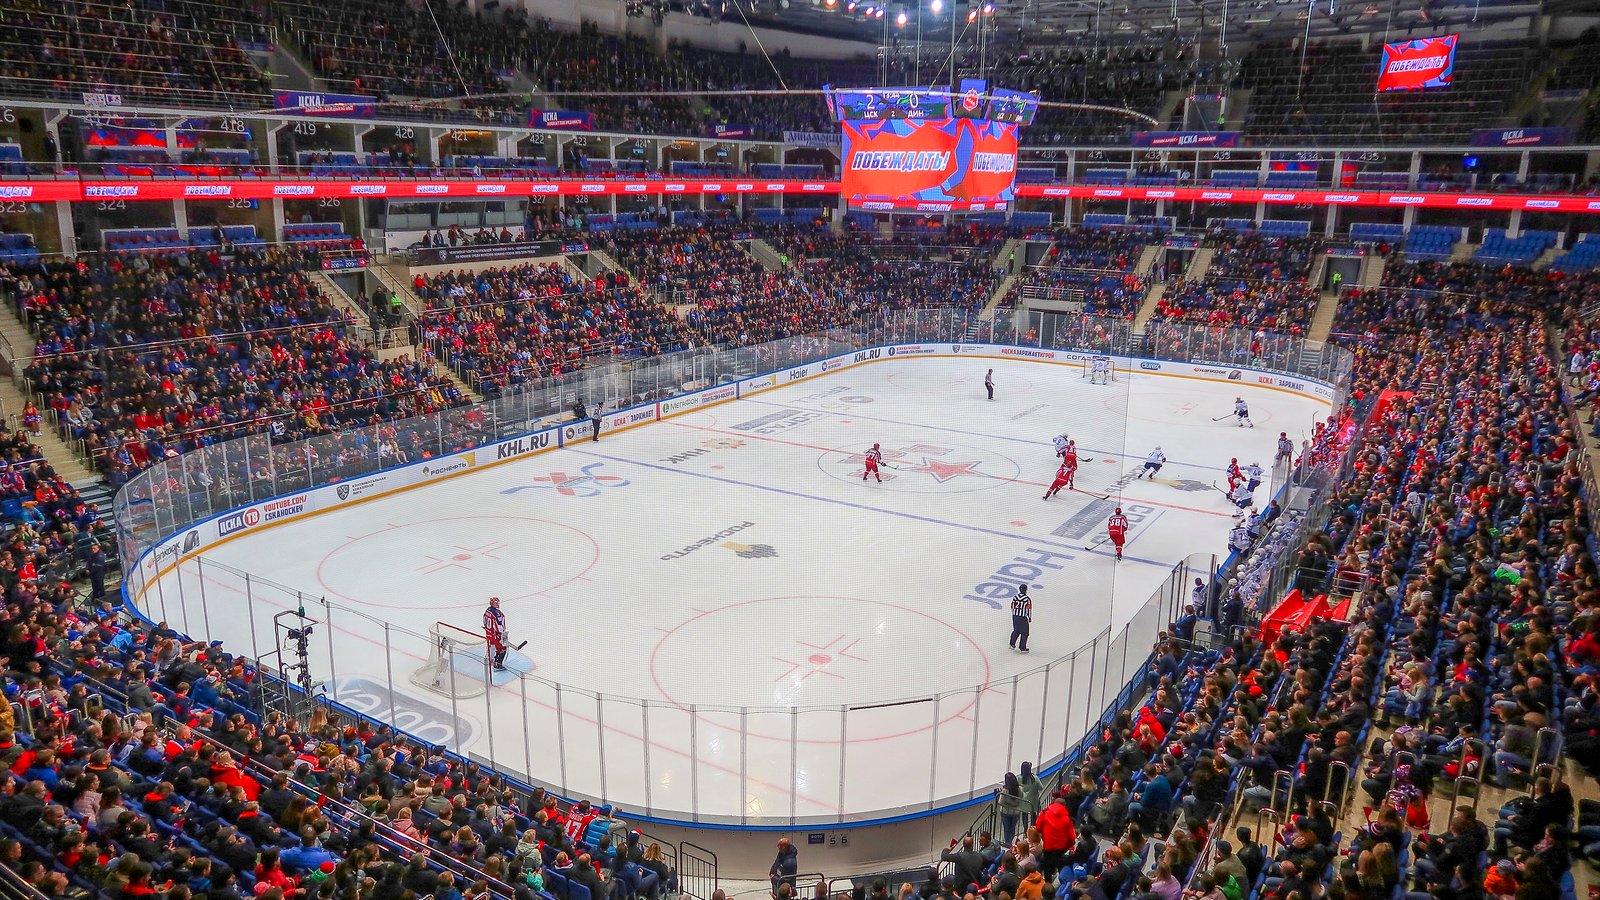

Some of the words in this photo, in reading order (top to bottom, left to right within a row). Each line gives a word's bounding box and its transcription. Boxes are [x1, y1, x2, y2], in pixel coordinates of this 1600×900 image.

[1387, 55, 1447, 73] ПОБЕЖДАТЬ!
[298, 95, 320, 107] ЦСКА
[866, 94, 875, 109] 2
[909, 93, 918, 108] 0
[542, 112, 558, 122] ЦСКА
[908, 110, 924, 118] ДИН
[220, 120, 245, 132] 418
[294, 123, 316, 135] 419
[395, 127, 414, 139] 420
[451, 129, 468, 141] 421
[1502, 130, 1523, 140] ЦСКА
[530, 135, 544, 144] 422
[573, 136, 587, 146] 423
[635, 139, 647, 148] 424
[1178, 135, 1198, 145] ЦСКА
[1041, 151, 1056, 159] 430
[1088, 151, 1103, 159] 431
[1145, 151, 1160, 159] 432
[1360, 152, 1378, 160] 435
[852, 151, 950, 172] ПОБЕЖДАТЬ!
[972, 151, 1015, 174] ПОБЕЖДАТЬ!
[228, 198, 251, 208] 325
[320, 197, 340, 207] 326
[533, 195, 545, 204] 327
[576, 195, 589, 203] 328
[636, 194, 648, 202] 329
[670, 193, 682, 202] 330
[98, 199, 126, 211] 324
[854, 348, 881, 363] KHL.RU
[790, 367, 808, 381] Haier
[1258, 376, 1273, 384] ЦСКА
[1279, 380, 1304, 391] ЗАРЯЖАЕТ
[670, 397, 699, 410] МЕГАФОН
[614, 417, 626, 427] ЦСКА
[630, 409, 654, 422] ЗАРЯЖАЕТ
[497, 432, 549, 459] KHL.RU
[430, 462, 467, 476] РОСНЕФТЬ
[264, 495, 307, 512] YOUTUBE.COM/
[264, 505, 304, 521] CSKAHOCKEY
[219, 517, 243, 535] ЦСКА
[246, 512, 259, 525] ТВ
[660, 520, 756, 561] РОСНЕФТЬ
[963, 547, 1075, 610] Haier
[830, 837, 836, 845] 5
[841, 836, 848, 844] 6
